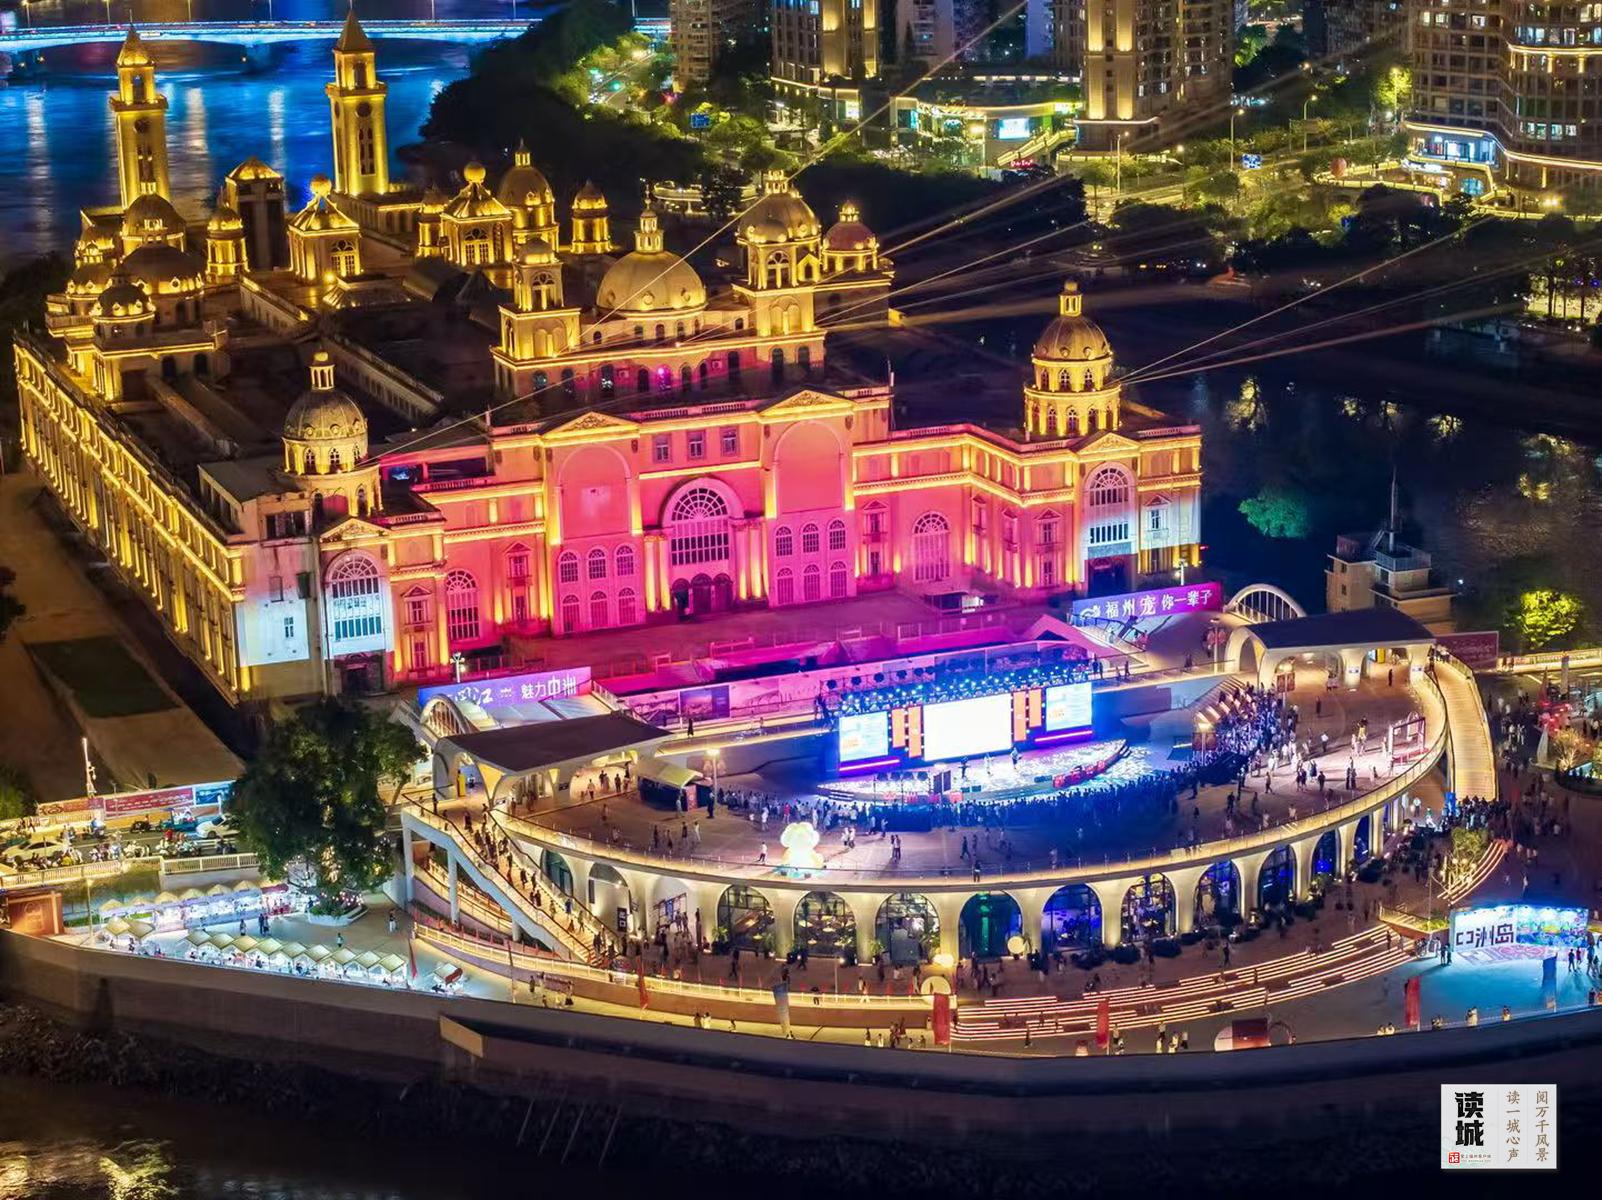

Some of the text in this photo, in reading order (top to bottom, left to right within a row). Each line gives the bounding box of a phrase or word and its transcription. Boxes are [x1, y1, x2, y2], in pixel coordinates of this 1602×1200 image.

[1106, 590, 1212, 618] 福州宠你一辈子
[521, 675, 576, 699] 魅力中洲
